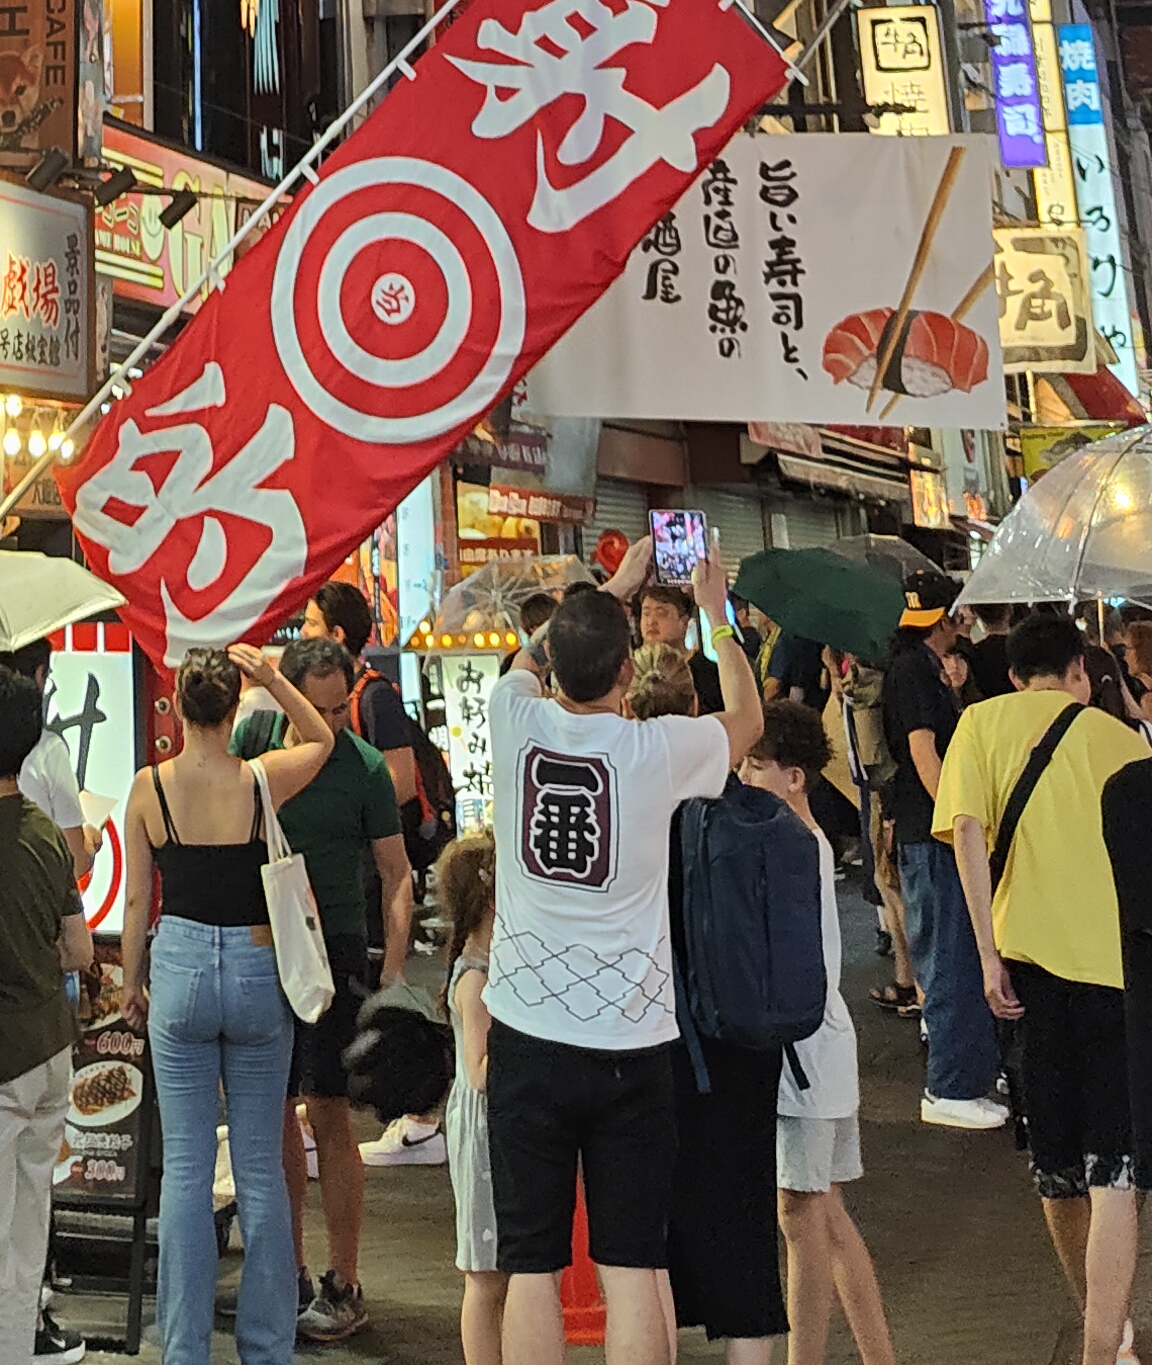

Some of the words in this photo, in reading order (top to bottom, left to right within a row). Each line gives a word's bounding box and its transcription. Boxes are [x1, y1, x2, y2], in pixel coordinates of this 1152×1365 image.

[1058, 39, 1099, 113] 焼肉
[63, 232, 82, 363] 景品付
[700, 158, 749, 360] 産直の魚の
[757, 157, 808, 381] 旨い寿司と、
[1074, 153, 1128, 366] いろりや
[527, 755, 604, 879] 一番
[97, 1031, 146, 1056] 600円
